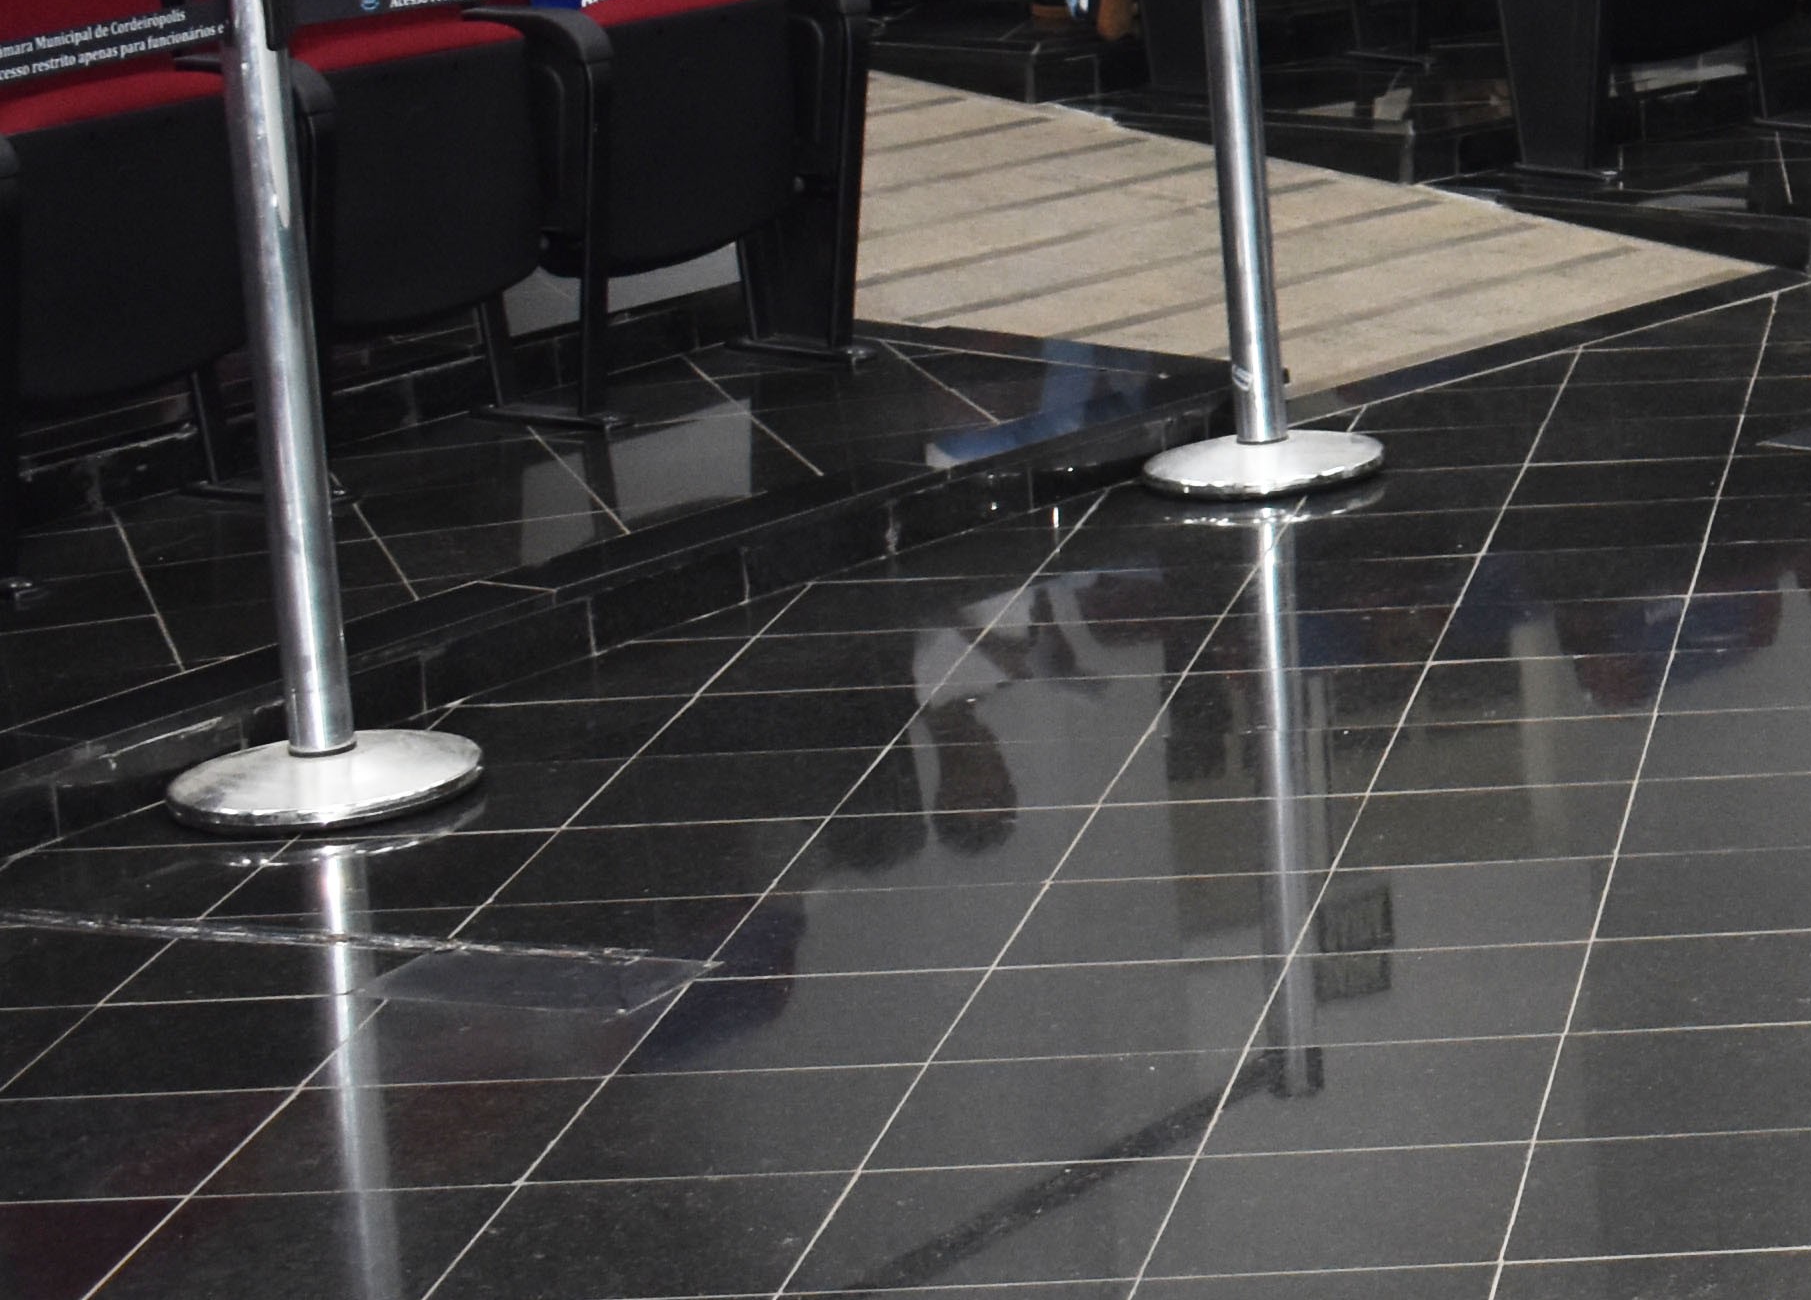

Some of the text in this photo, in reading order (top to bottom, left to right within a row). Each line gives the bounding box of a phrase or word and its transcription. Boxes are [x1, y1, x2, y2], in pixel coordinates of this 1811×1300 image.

[0, 39, 33, 58] âmara
[35, 28, 93, 50] Municipal
[94, 24, 109, 39] de
[0, 64, 30, 81] cesso
[32, 53, 76, 74] restrito
[78, 47, 118, 67] apenas
[120, 41, 146, 59] para
